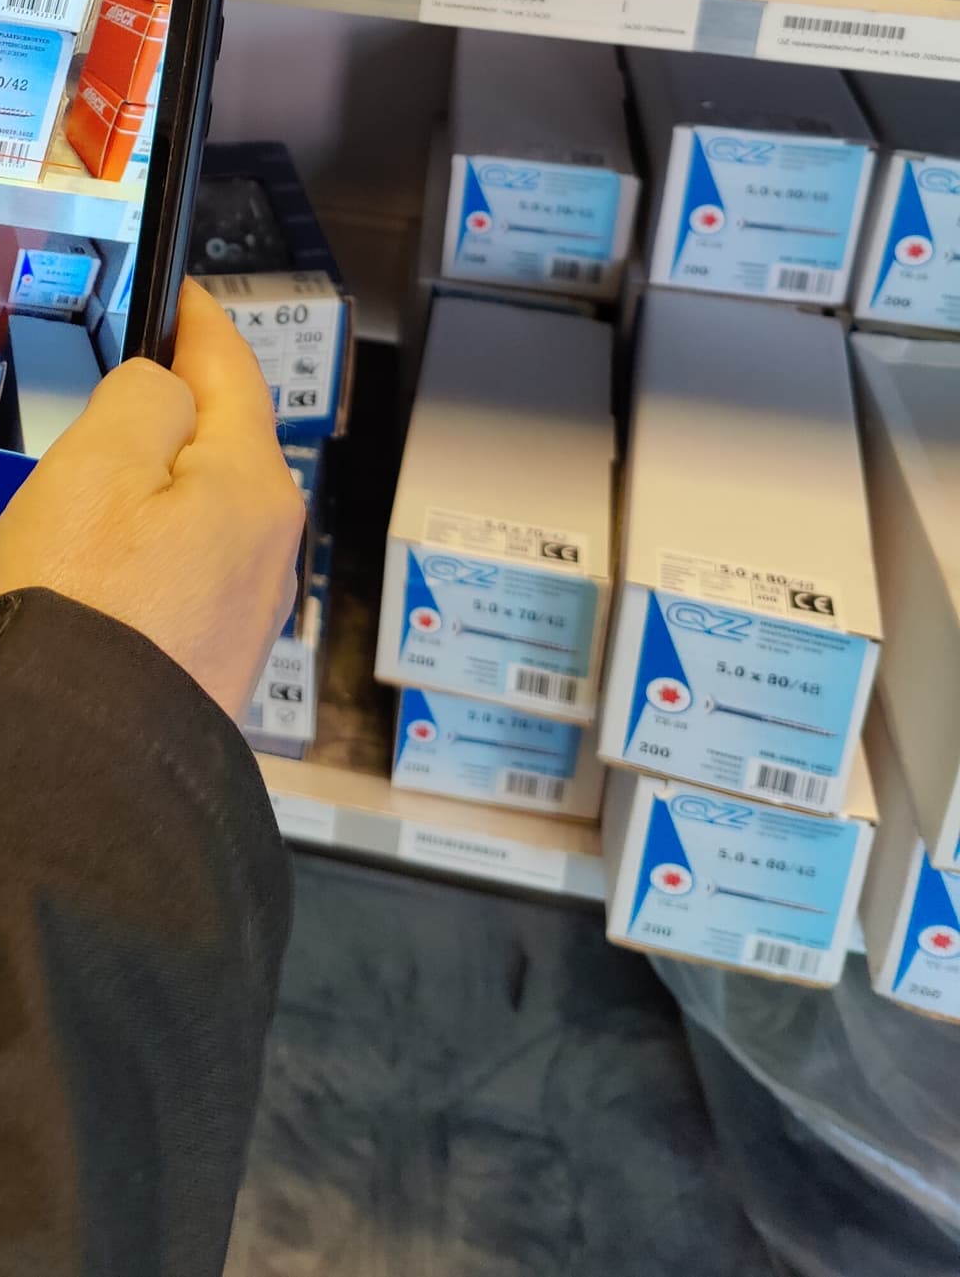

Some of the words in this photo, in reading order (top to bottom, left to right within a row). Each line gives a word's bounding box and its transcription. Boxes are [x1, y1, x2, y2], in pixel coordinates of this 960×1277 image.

[248, 311, 263, 326] x
[275, 304, 309, 325] 60
[295, 331, 323, 343] 200
[423, 554, 499, 588] QZ
[666, 601, 753, 643] QZ
[716, 661, 745, 678] 5.0
[750, 672, 761, 682] x
[639, 741, 671, 759] 200
[670, 794, 753, 829] QZ
